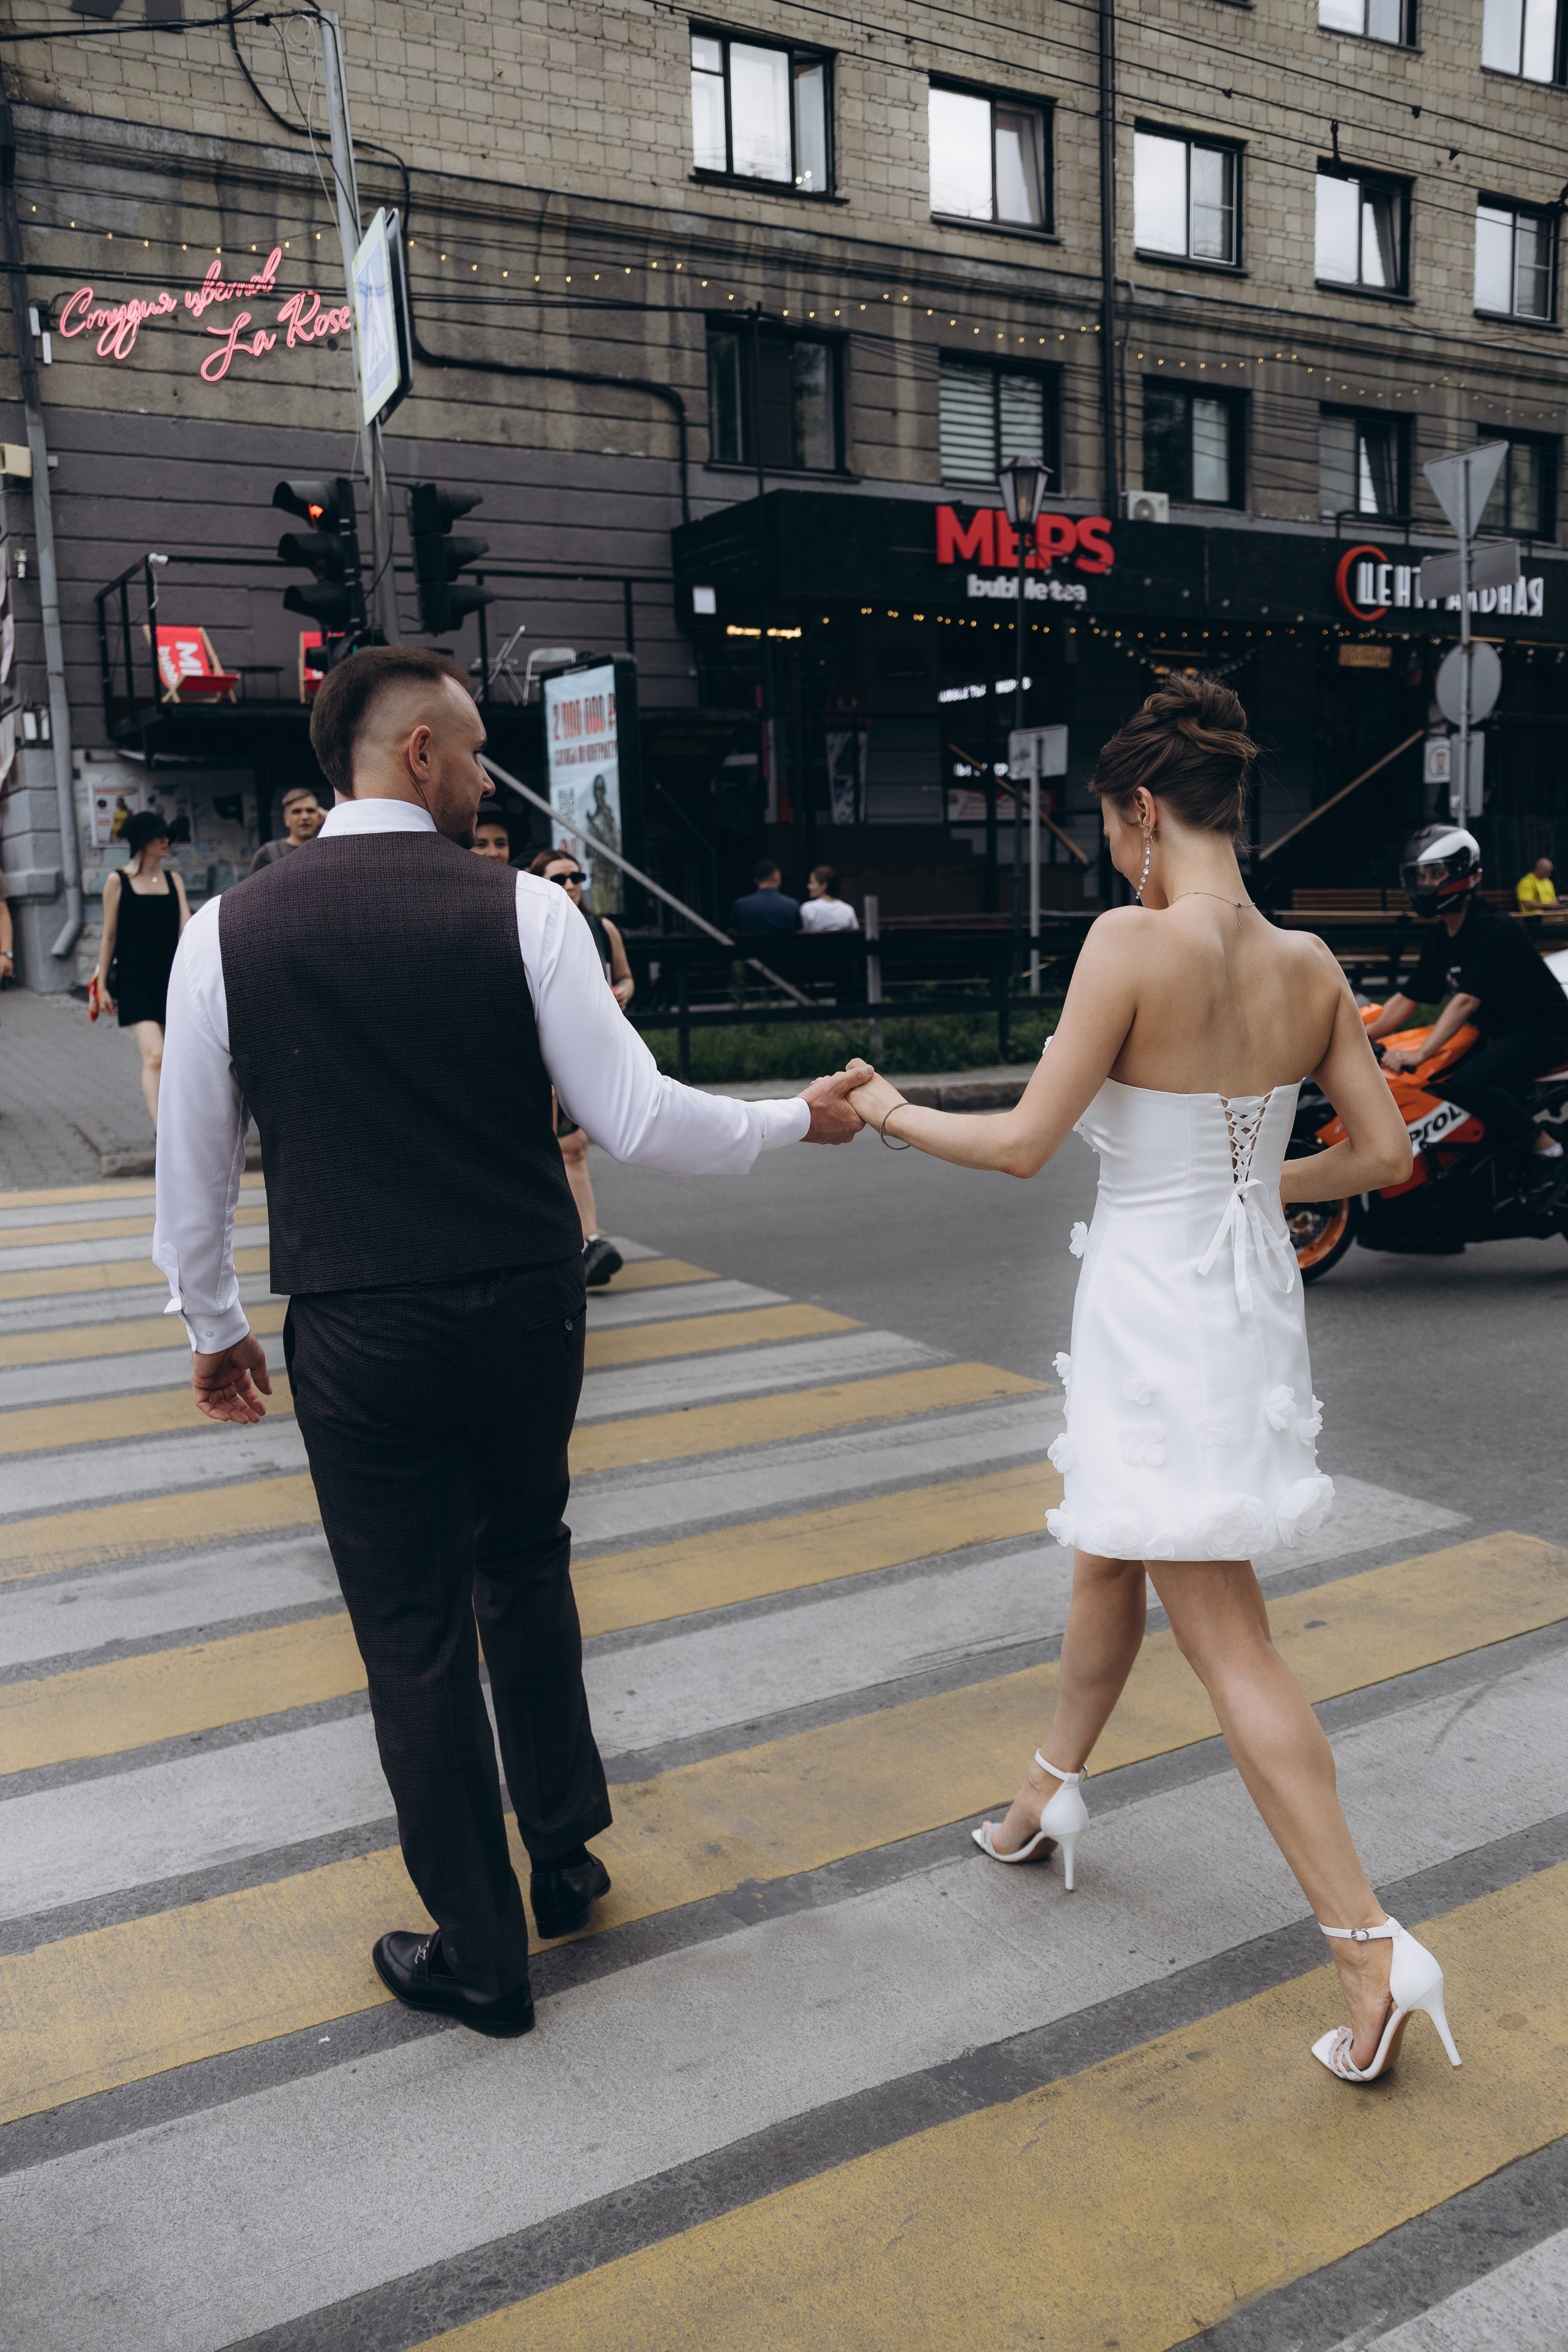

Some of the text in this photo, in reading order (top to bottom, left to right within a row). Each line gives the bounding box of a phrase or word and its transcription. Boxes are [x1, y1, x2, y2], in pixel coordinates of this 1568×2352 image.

[60, 246, 282, 360] Студия цветов
[200, 290, 352, 382] La Rose
[935, 505, 1115, 574] MEPS
[1355, 560, 1544, 617] ЦЕНТЬНАЯ
[1409, 1104, 1463, 1147] PSOL
